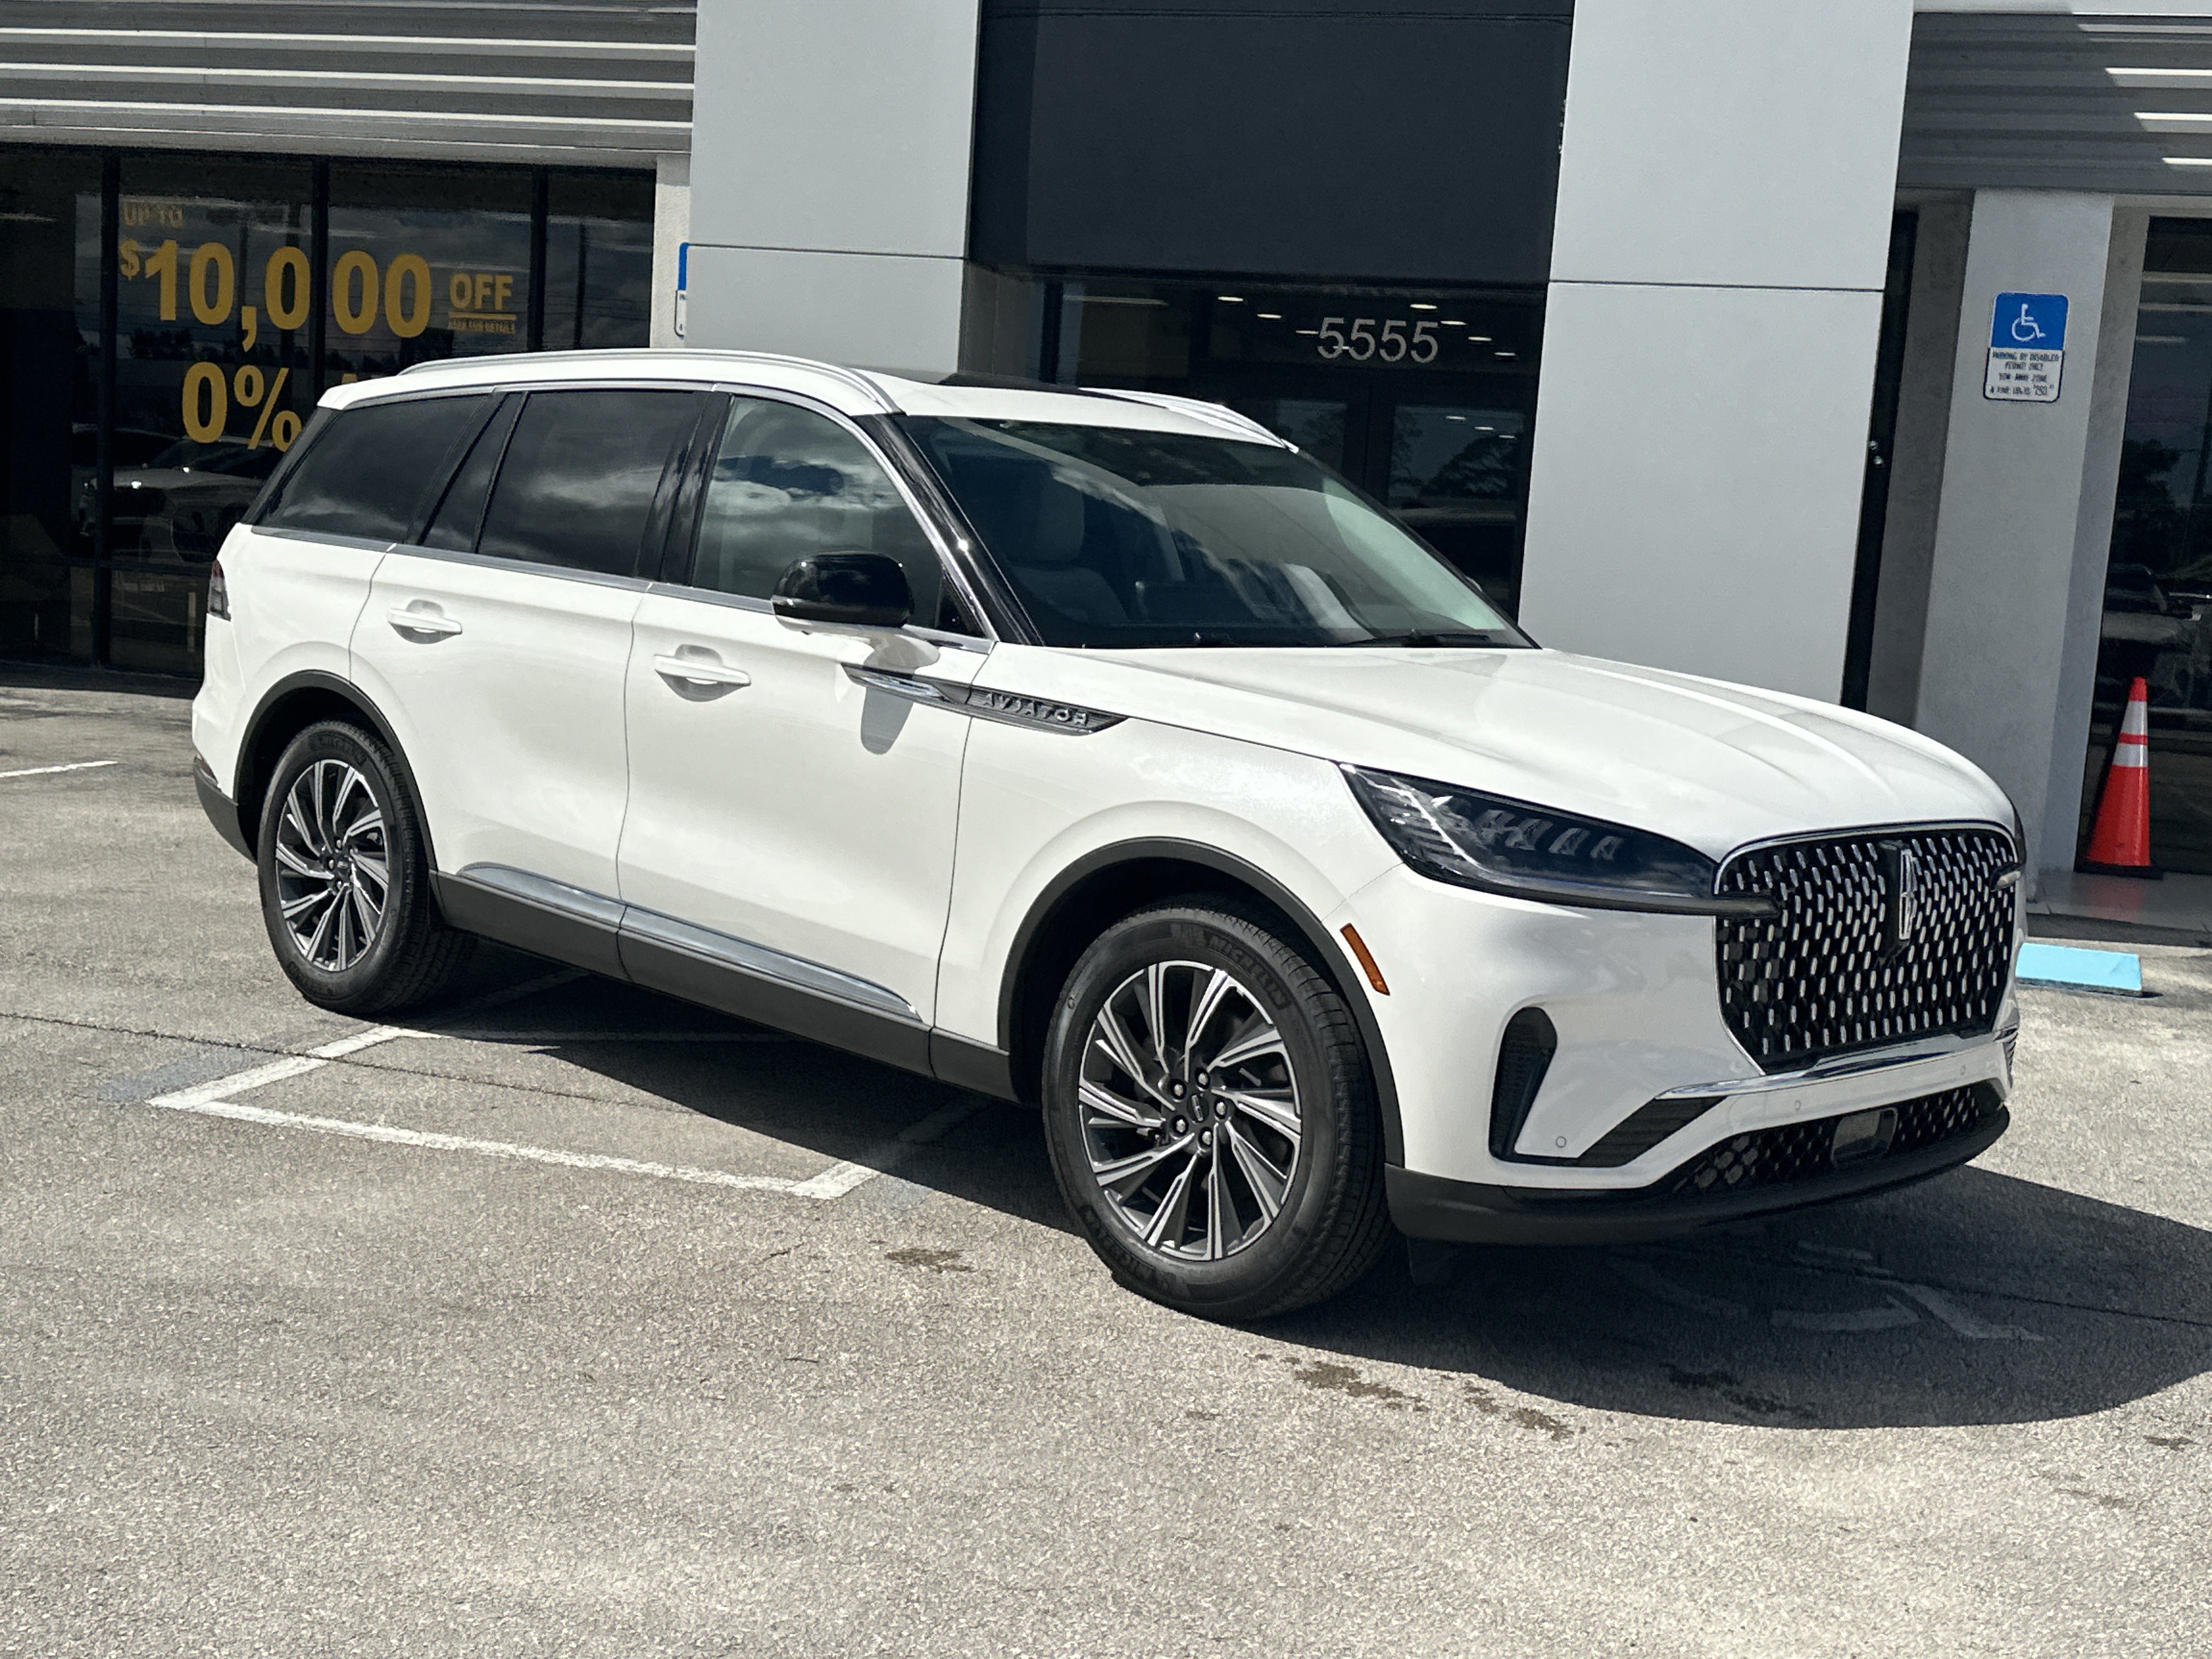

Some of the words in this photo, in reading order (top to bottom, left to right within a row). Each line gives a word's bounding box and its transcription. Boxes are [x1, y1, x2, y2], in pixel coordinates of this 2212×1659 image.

[120, 238, 432, 353] $10,000
[449, 272, 513, 310] OFF
[1317, 317, 1438, 363] 5555
[182, 362, 302, 452] 0%
[983, 693, 1088, 726] AVIATOR
